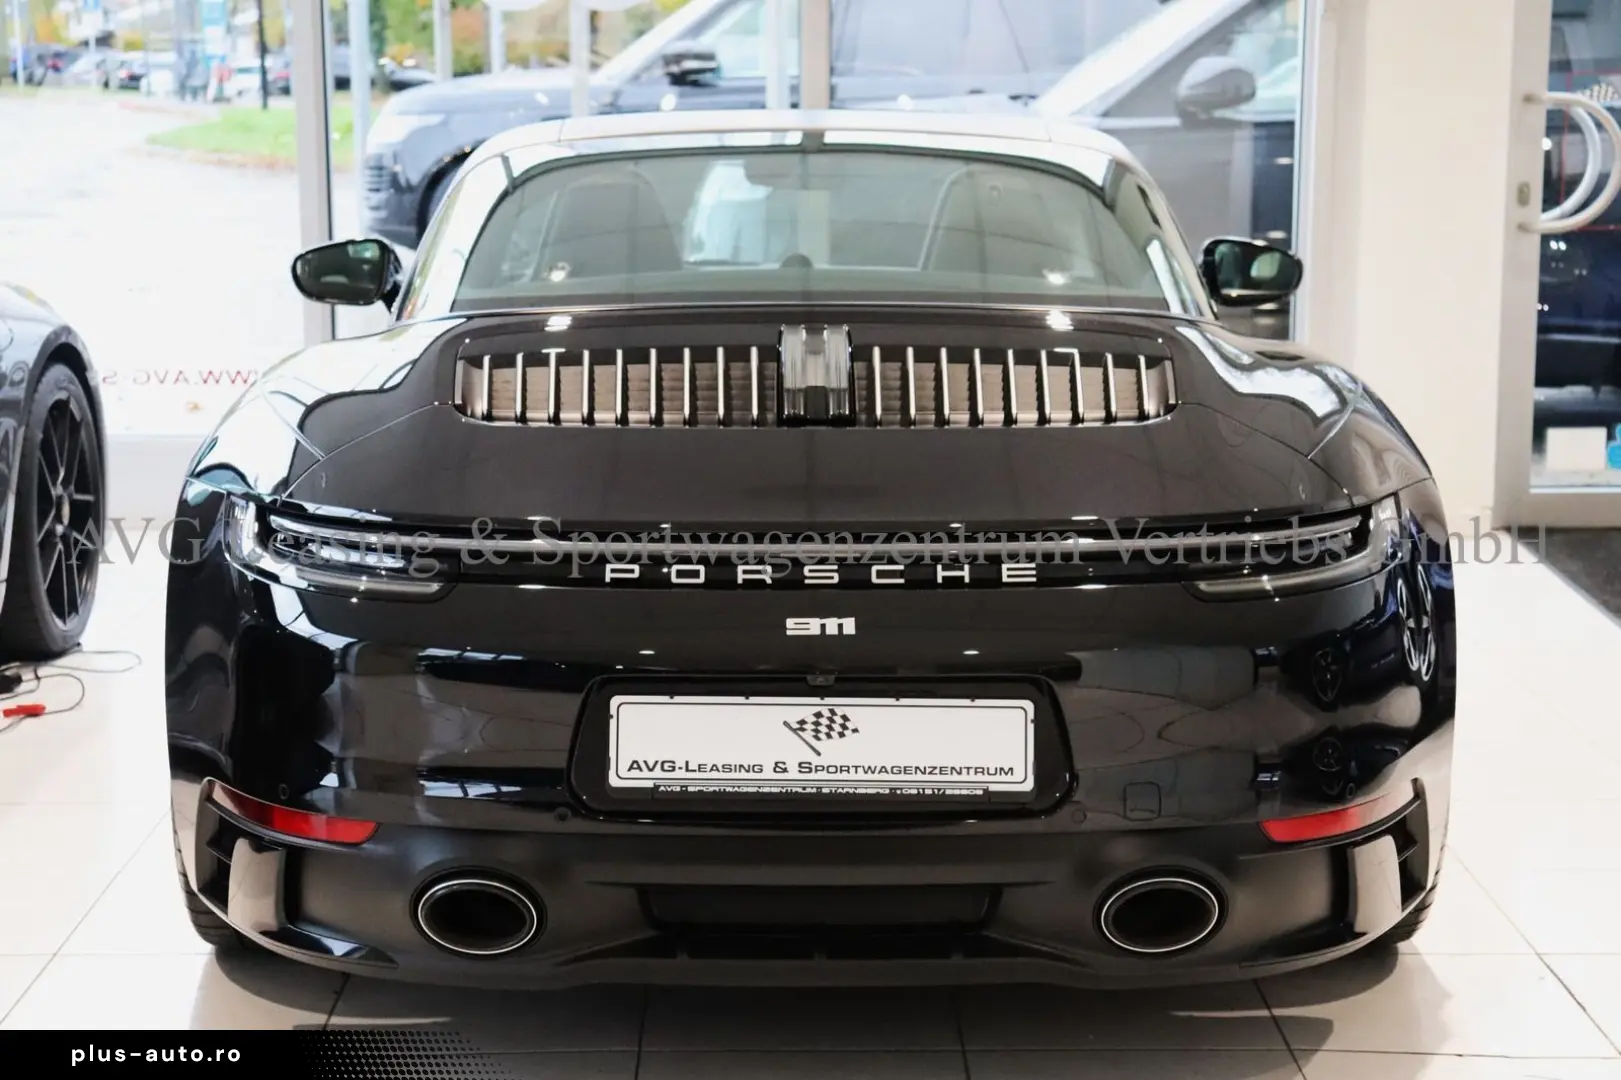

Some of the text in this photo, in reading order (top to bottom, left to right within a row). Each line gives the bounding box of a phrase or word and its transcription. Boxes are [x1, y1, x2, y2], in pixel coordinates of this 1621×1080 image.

[605, 563, 1037, 585] PORSCHE
[785, 616, 856, 636] 911
[772, 761, 789, 774] &
